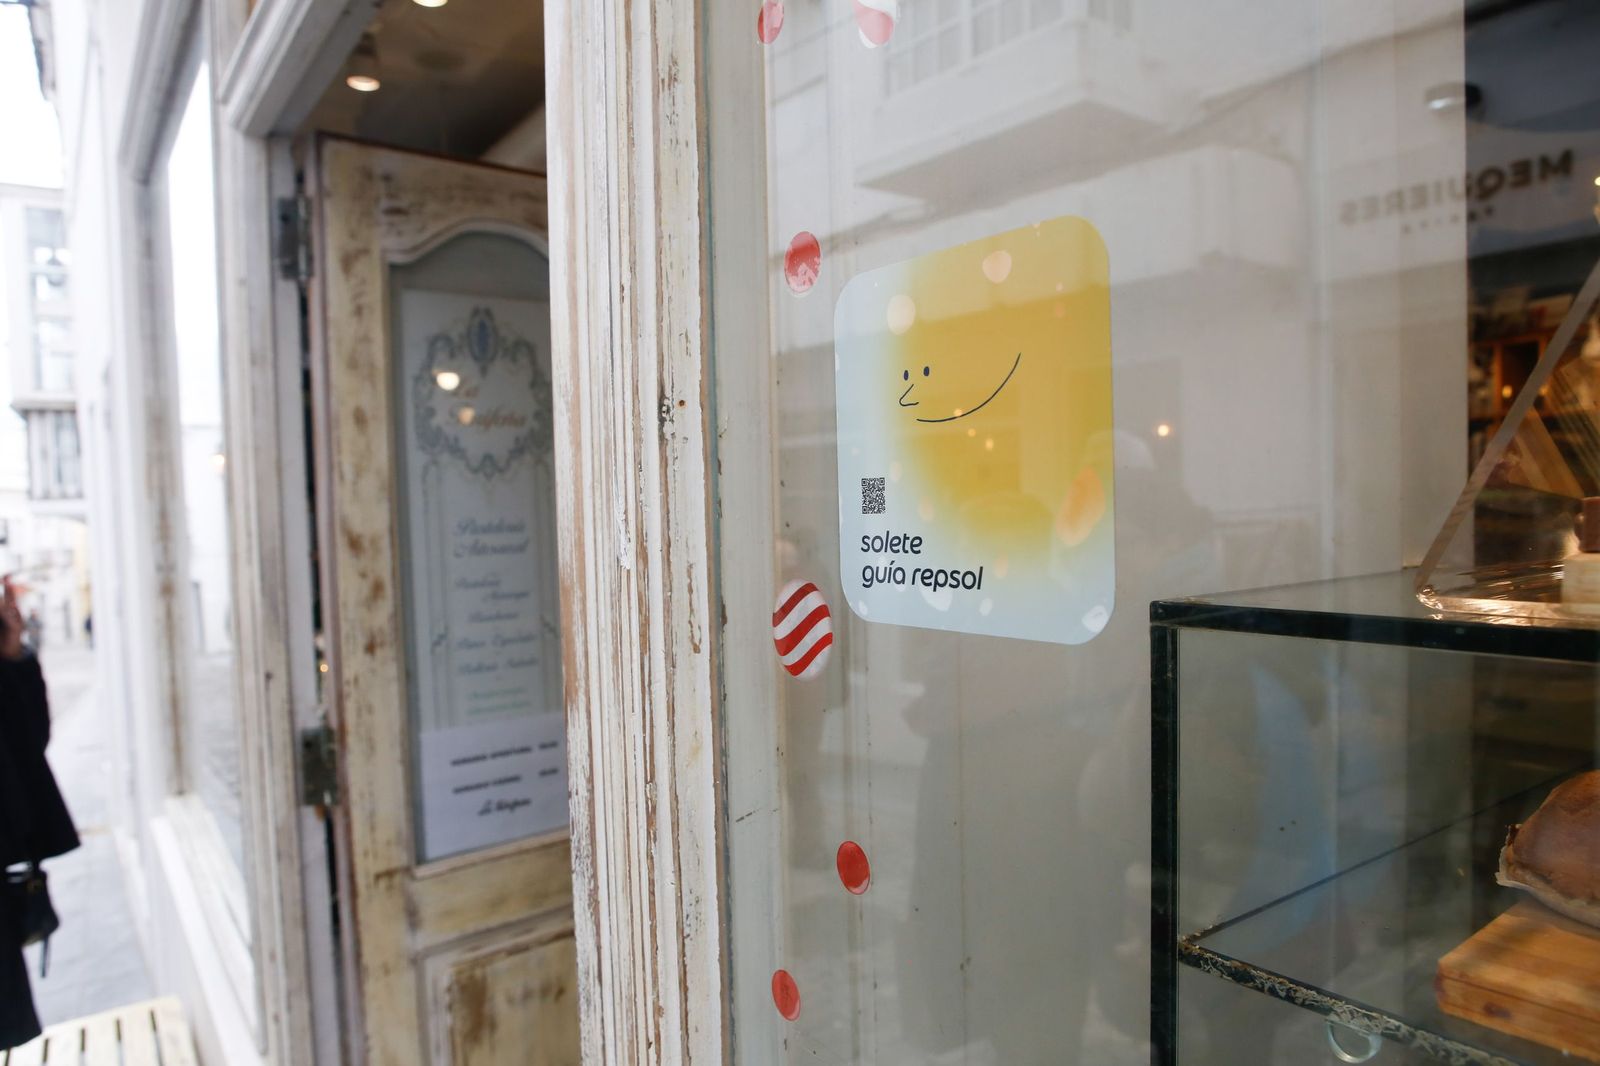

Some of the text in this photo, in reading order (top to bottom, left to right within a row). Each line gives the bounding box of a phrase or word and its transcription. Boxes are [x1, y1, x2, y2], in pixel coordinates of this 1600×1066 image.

[860, 529, 923, 555] solete
[861, 560, 984, 592] guía repsol
